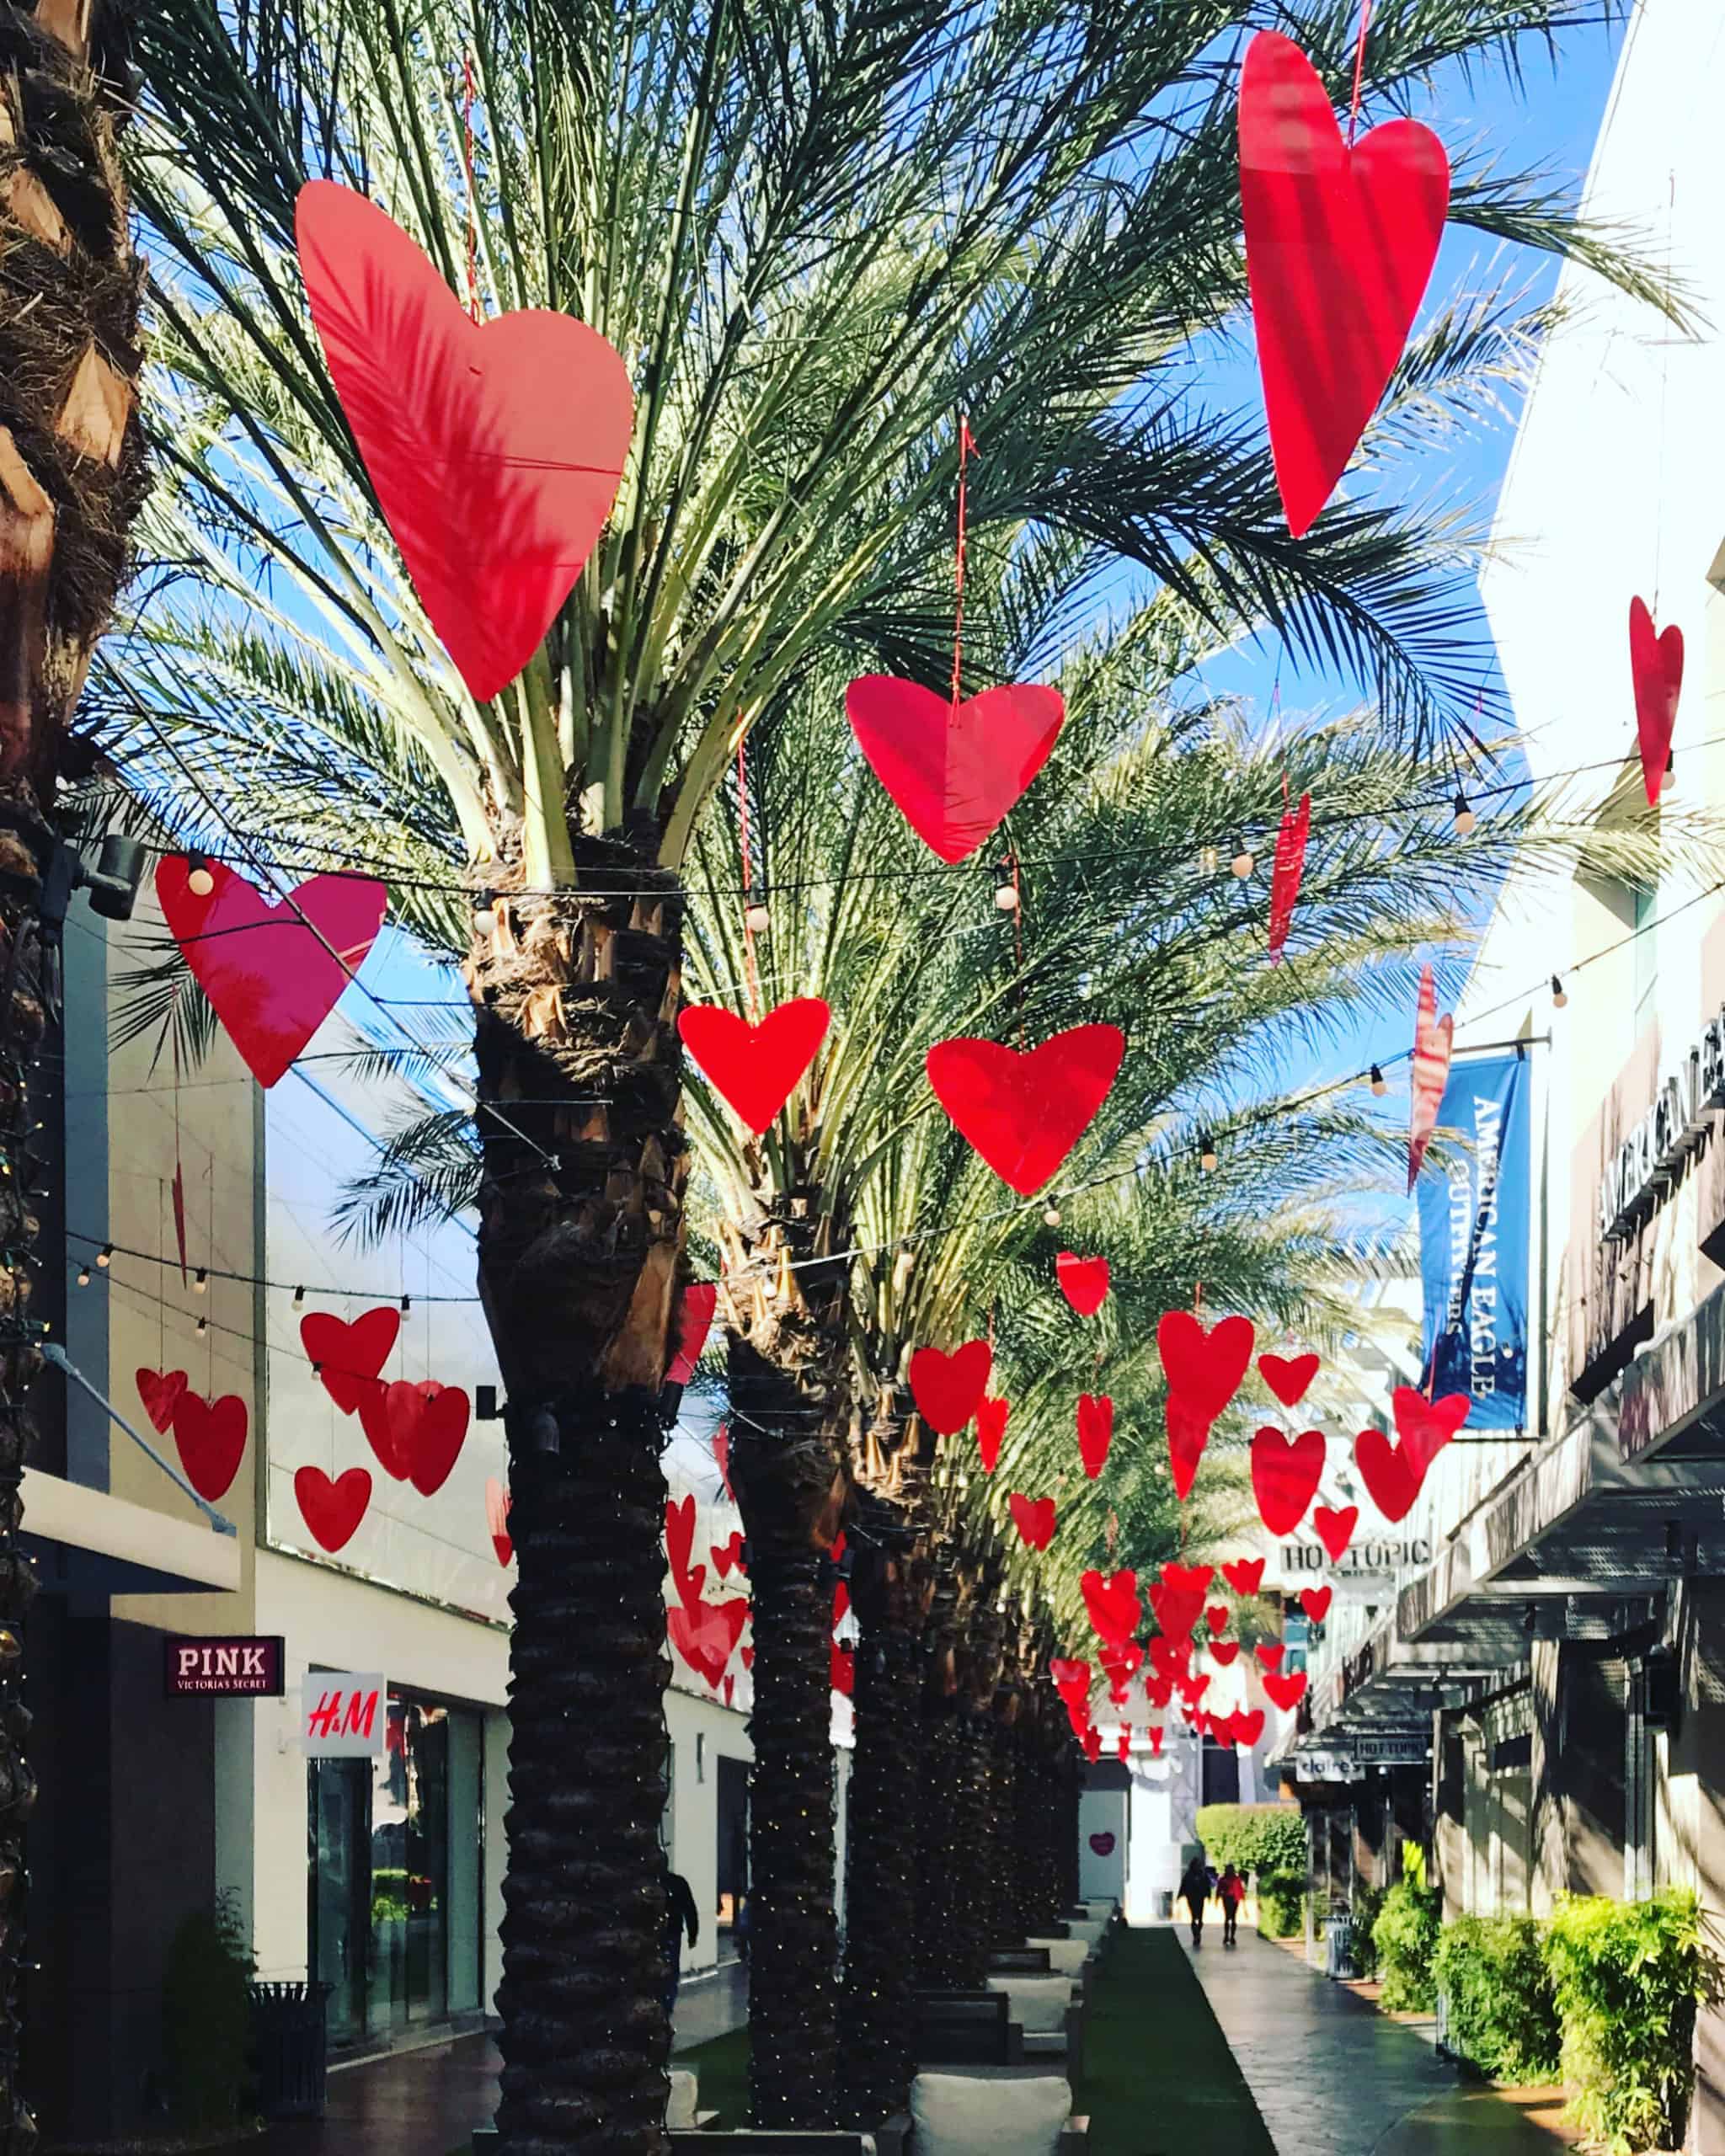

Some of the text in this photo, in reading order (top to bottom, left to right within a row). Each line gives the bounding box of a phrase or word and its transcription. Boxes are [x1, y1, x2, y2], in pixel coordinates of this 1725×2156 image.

[1470, 1289, 1497, 1395] EAGLE
[1285, 1539, 1430, 1571] HO TOPIC
[178, 1647, 265, 1676] PINK
[232, 1678, 266, 1689] SECRET
[308, 1689, 379, 1739] H&M
[1359, 1742, 1385, 1754] HOT
